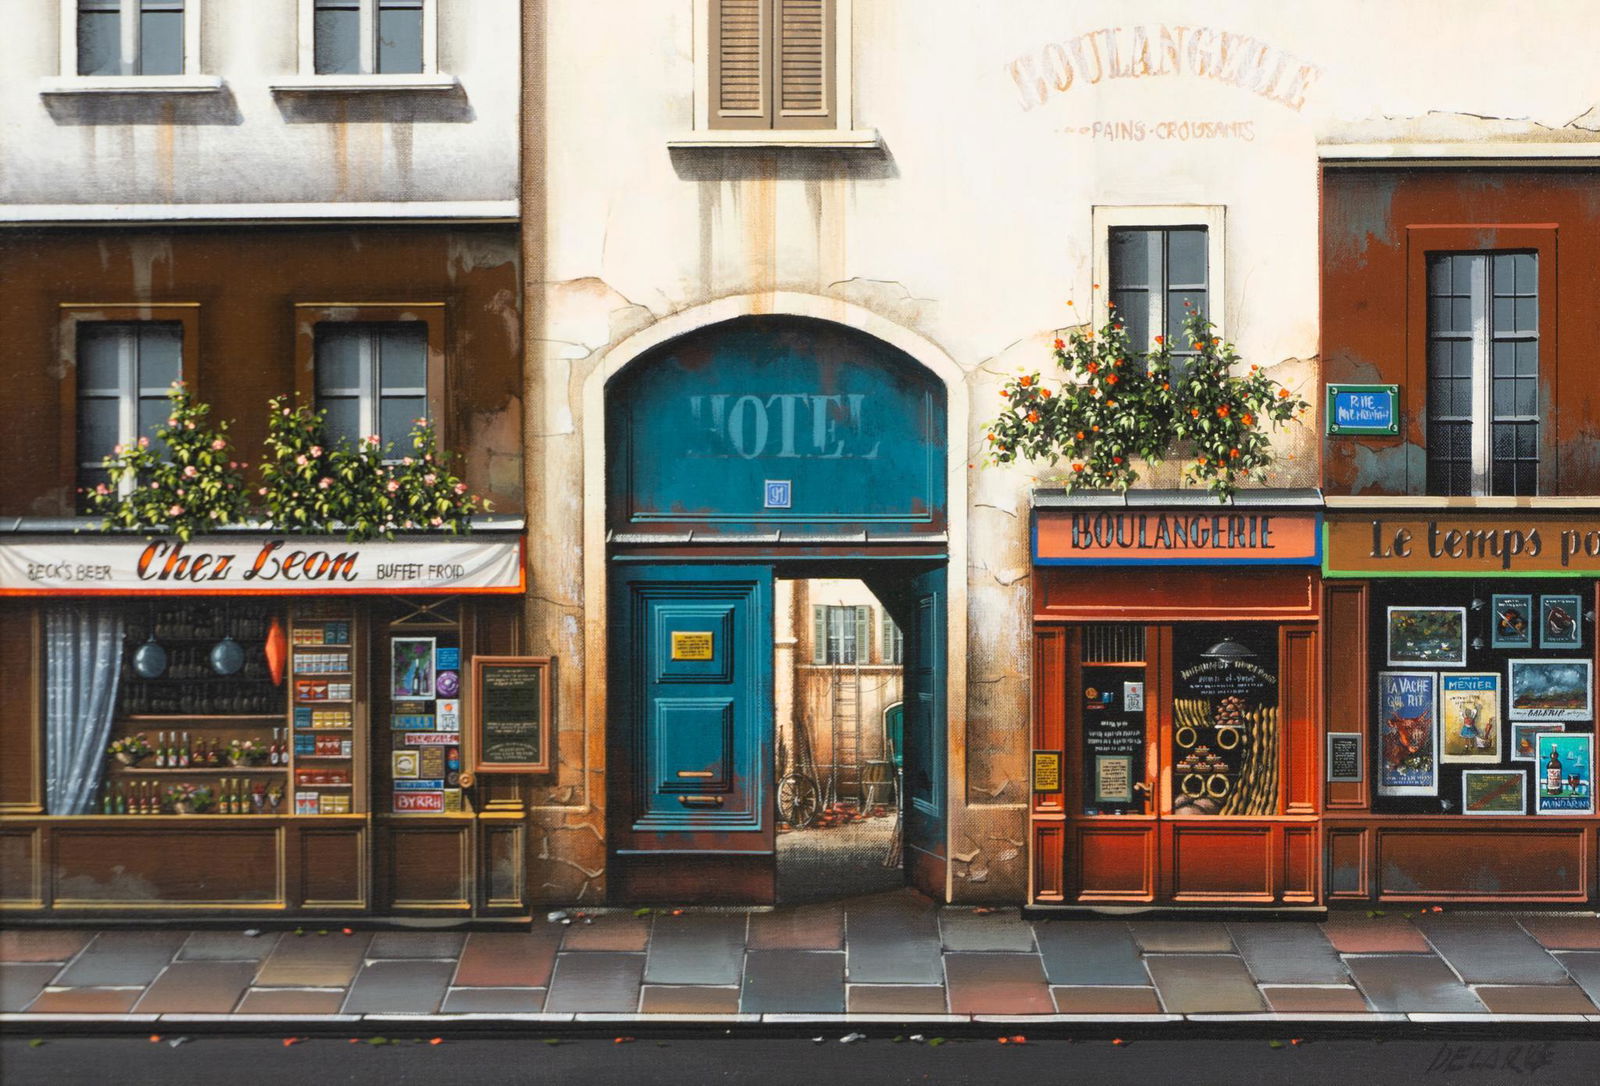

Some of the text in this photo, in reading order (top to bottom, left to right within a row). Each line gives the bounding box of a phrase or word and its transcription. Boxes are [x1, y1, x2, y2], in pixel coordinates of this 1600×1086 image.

[1071, 511, 1276, 549] BOULANGERIE
[1370, 519, 1412, 558] Le
[1428, 520, 1542, 569] temps
[137, 539, 359, 582] Chez Leon
[27, 562, 112, 581] BECK'S BEER
[376, 563, 465, 580] BUFFET FROID
[1399, 678, 1429, 693] VACHE
[1448, 680, 1492, 690] MENIER
[1408, 694, 1423, 707] RIT
[399, 796, 441, 808] BYRRH
